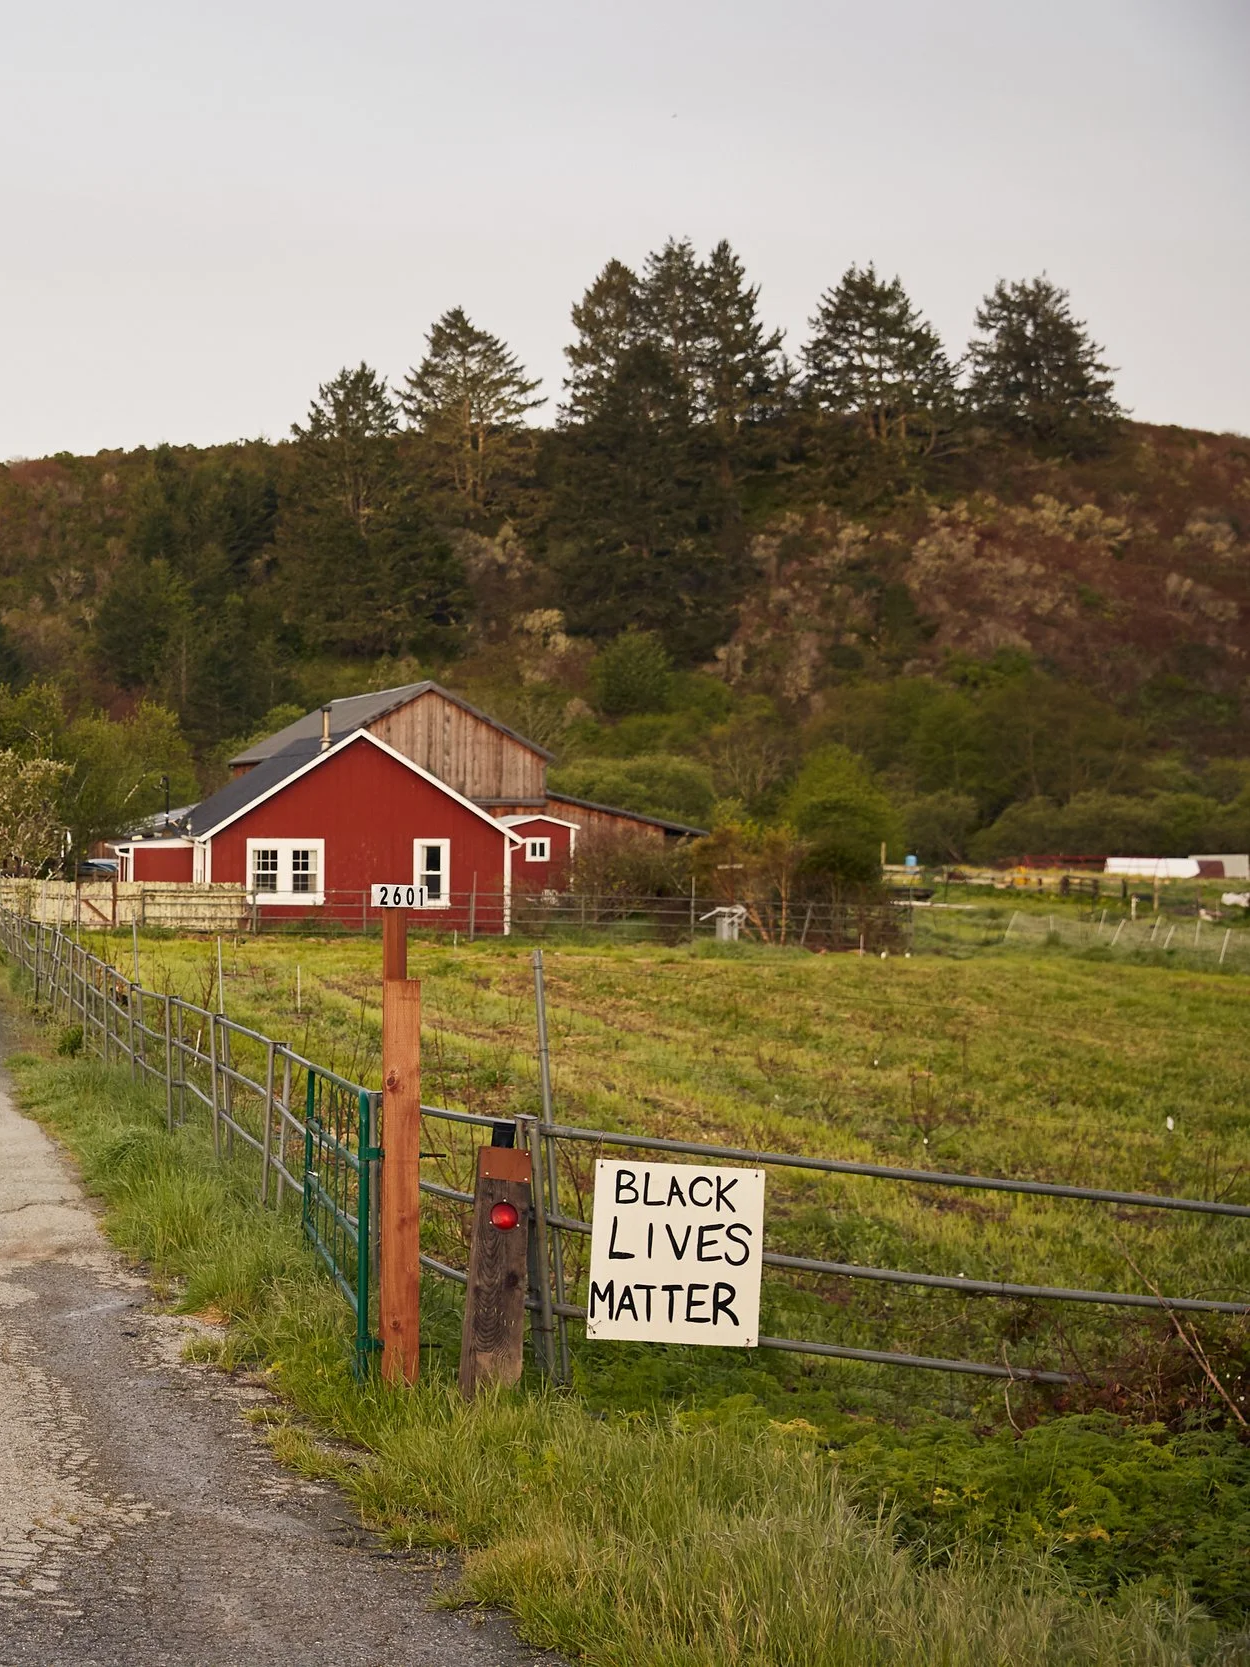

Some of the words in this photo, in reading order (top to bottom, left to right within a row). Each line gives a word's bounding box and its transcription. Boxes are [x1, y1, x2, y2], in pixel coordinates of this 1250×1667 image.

[379, 886, 424, 907] 2601
[615, 1169, 739, 1213] BLACK
[608, 1215, 753, 1267] LIVES
[589, 1279, 740, 1327] MATTER
